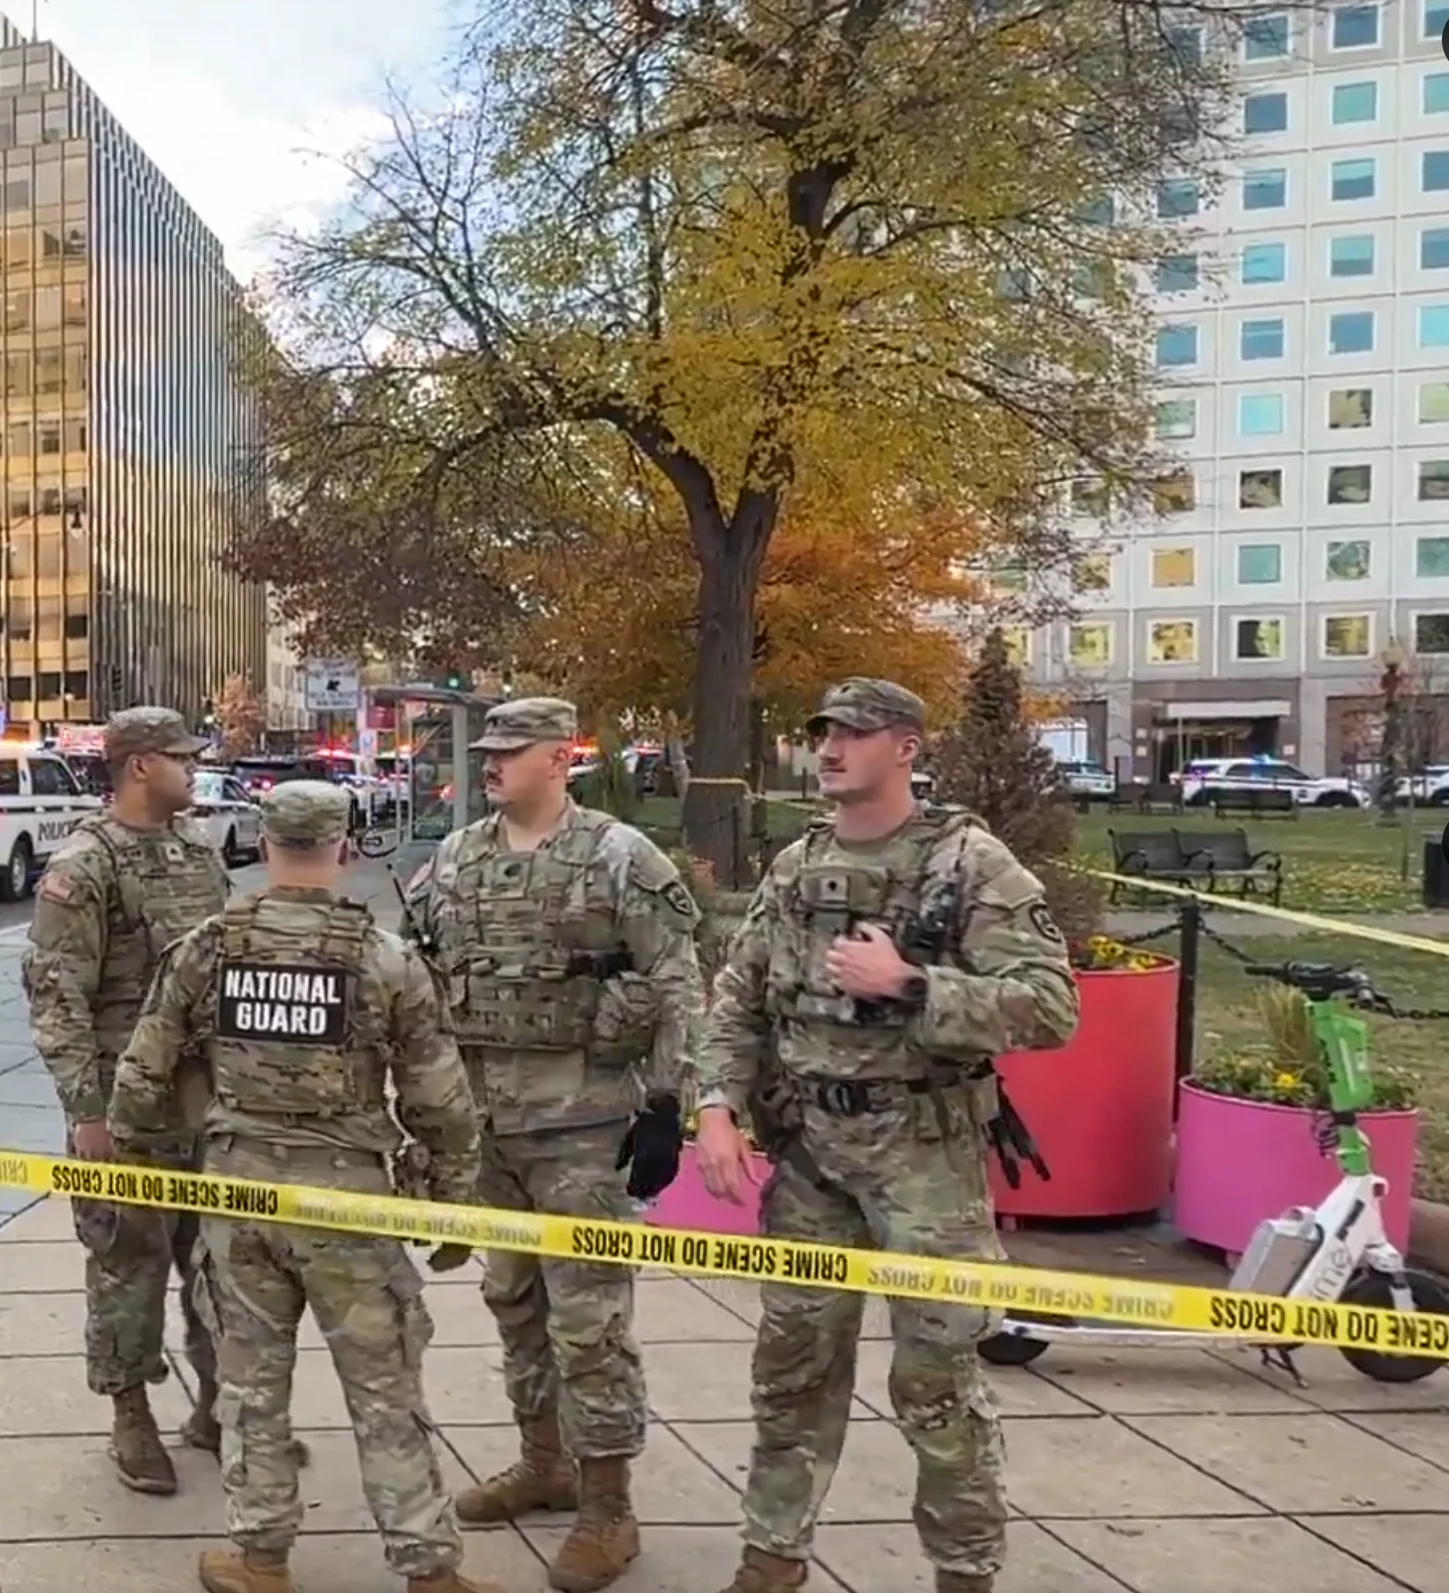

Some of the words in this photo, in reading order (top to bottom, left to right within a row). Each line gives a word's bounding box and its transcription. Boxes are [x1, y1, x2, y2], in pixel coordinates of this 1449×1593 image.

[225, 969, 341, 1004] NATIONAL
[235, 1002, 327, 1035] GUARD
[49, 1165, 103, 1195] CROSS
[105, 1170, 139, 1199] NOT
[140, 1174, 166, 1201] DO
[166, 1177, 220, 1208] SCENE
[222, 1184, 279, 1215] CRIME
[570, 1225, 634, 1259] CROSS
[636, 1232, 676, 1264] NOT
[680, 1237, 708, 1267] DO
[712, 1240, 777, 1275] SCENE
[781, 1247, 849, 1282] CRIME
[1207, 1295, 1286, 1334] CROSS
[1290, 1304, 1339, 1339] NOT
[1345, 1309, 1379, 1343] DO
[1383, 1313, 1449, 1351] CENE
